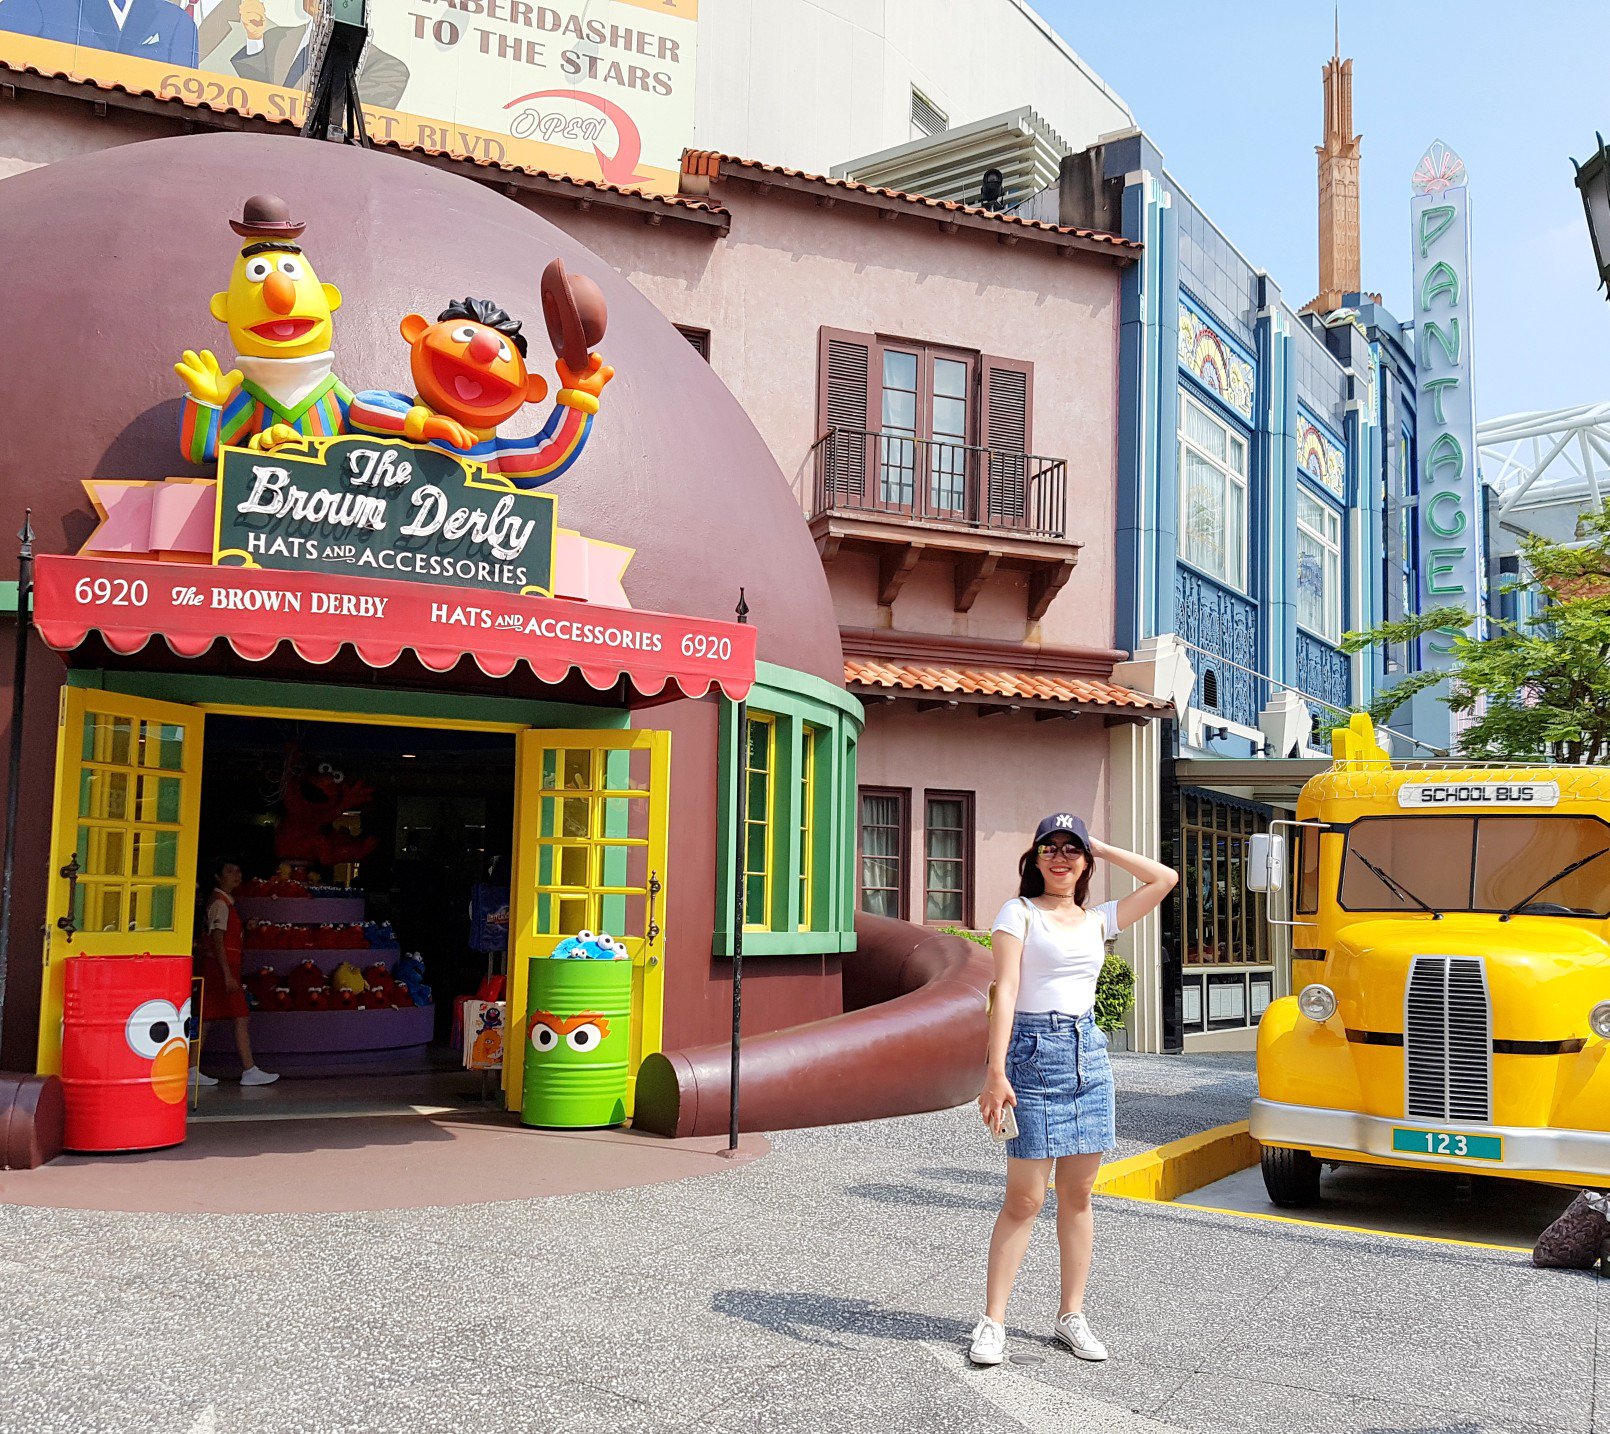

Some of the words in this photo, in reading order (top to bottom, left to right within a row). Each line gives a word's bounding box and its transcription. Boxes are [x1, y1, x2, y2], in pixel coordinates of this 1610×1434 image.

[421, 0, 680, 63] BERDASHER
[408, 12, 459, 45] TO
[474, 28, 547, 68] THE
[560, 49, 673, 96] STARS
[160, 74, 249, 109] 6920
[268, 94, 400, 138] SUT
[417, 125, 505, 162] BLVD
[509, 108, 607, 141] OPEN
[347, 448, 413, 488] The
[236, 465, 388, 531] Brown
[400, 483, 536, 561] Derby
[248, 532, 318, 559] HATS
[322, 545, 356, 562] AND
[357, 547, 528, 585] ACCESSORIES
[74, 577, 149, 606] 6920
[171, 586, 205, 607] The
[211, 587, 302, 612] BROWN
[310, 592, 388, 618] DERBY
[430, 603, 492, 628] HATS
[495, 613, 524, 632] AND
[523, 617, 662, 652] ACCESSORIES
[681, 633, 731, 661] 6920
[1421, 787, 1491, 802] SCHOOL
[1496, 787, 1533, 801] BUS
[1056, 814, 1073, 828] NY
[1425, 1133, 1468, 1155] 123
